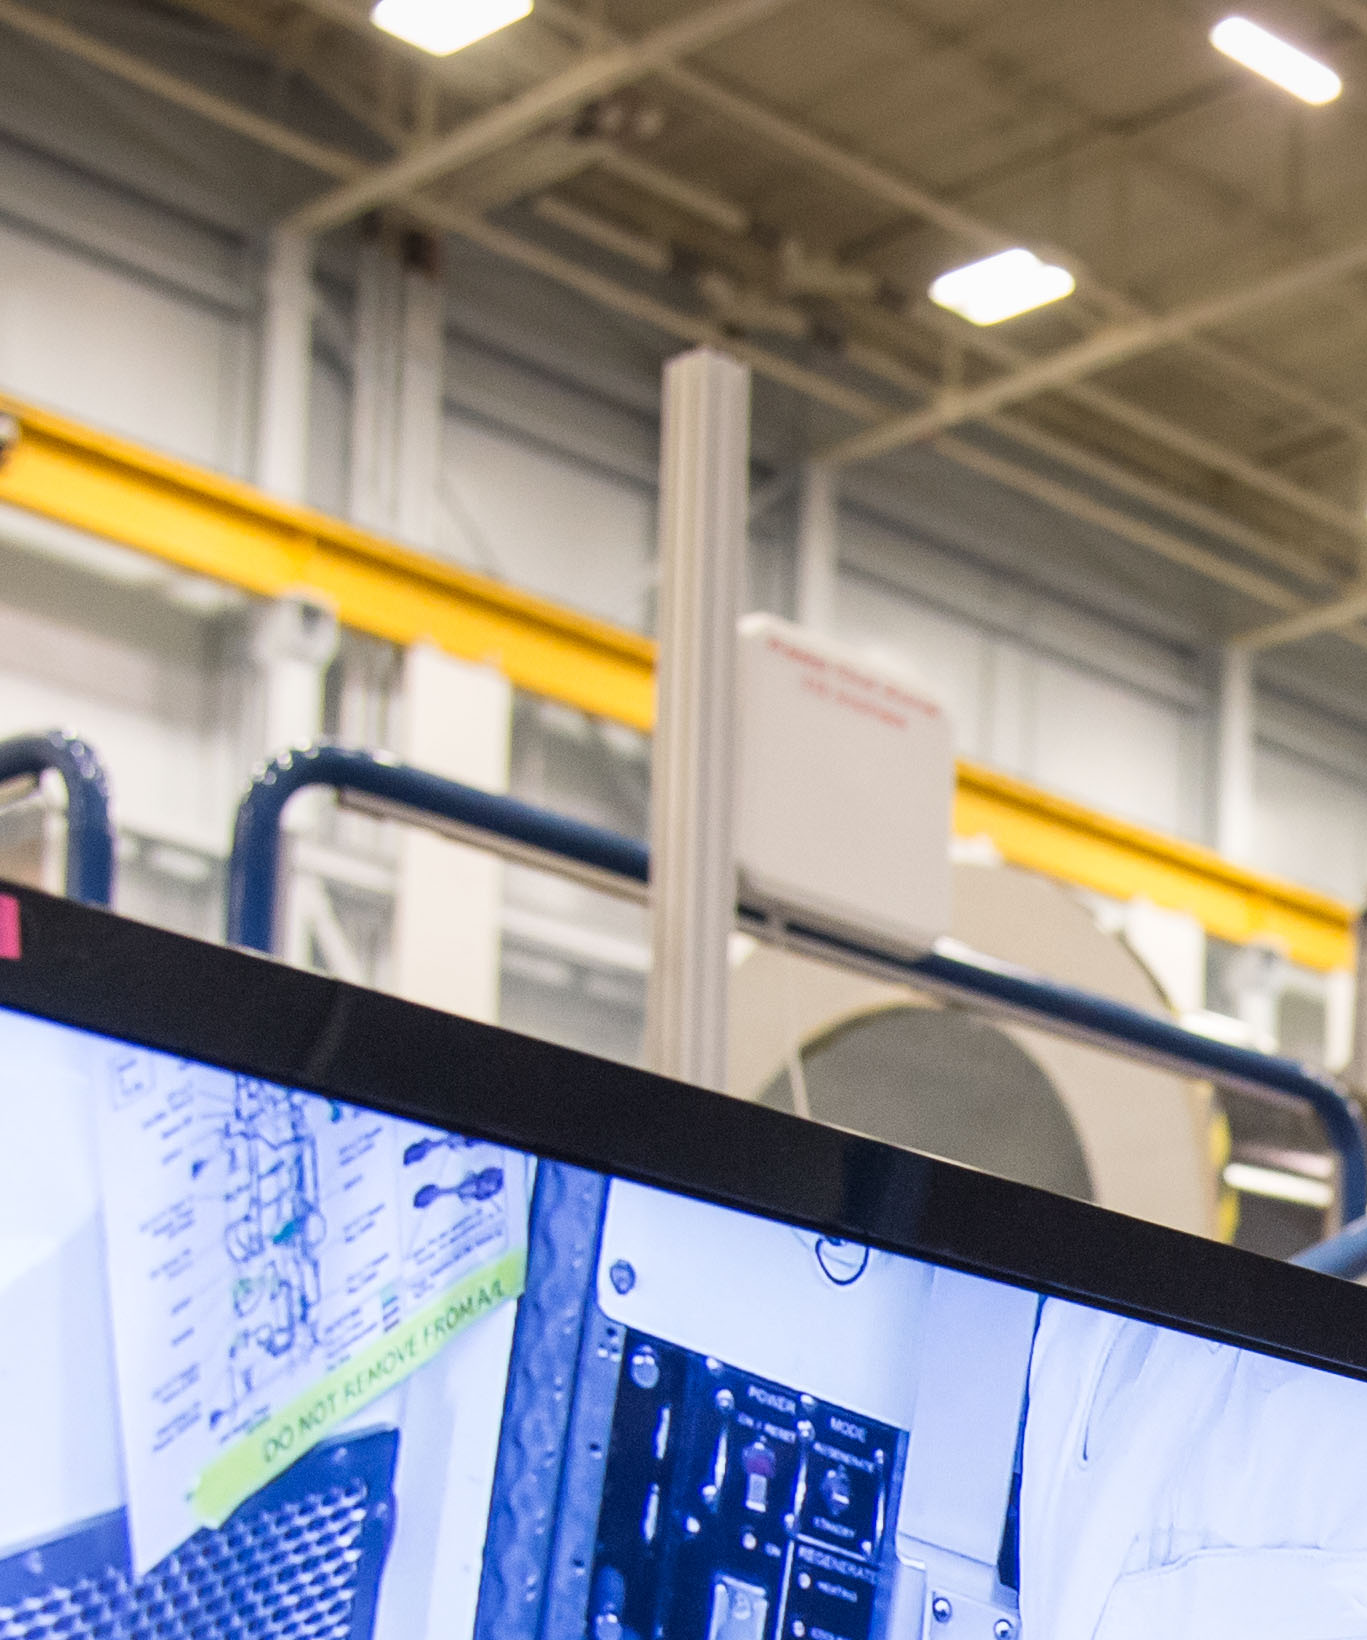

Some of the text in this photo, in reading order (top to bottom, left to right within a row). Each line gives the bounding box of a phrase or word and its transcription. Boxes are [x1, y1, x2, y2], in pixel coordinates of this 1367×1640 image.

[263, 1425, 295, 1463] DO
[299, 1392, 337, 1431] NOT
[344, 1336, 416, 1399] REMOVE
[424, 1293, 475, 1342] FROM
[748, 1384, 796, 1414] POWER
[829, 1415, 867, 1444] MODE
